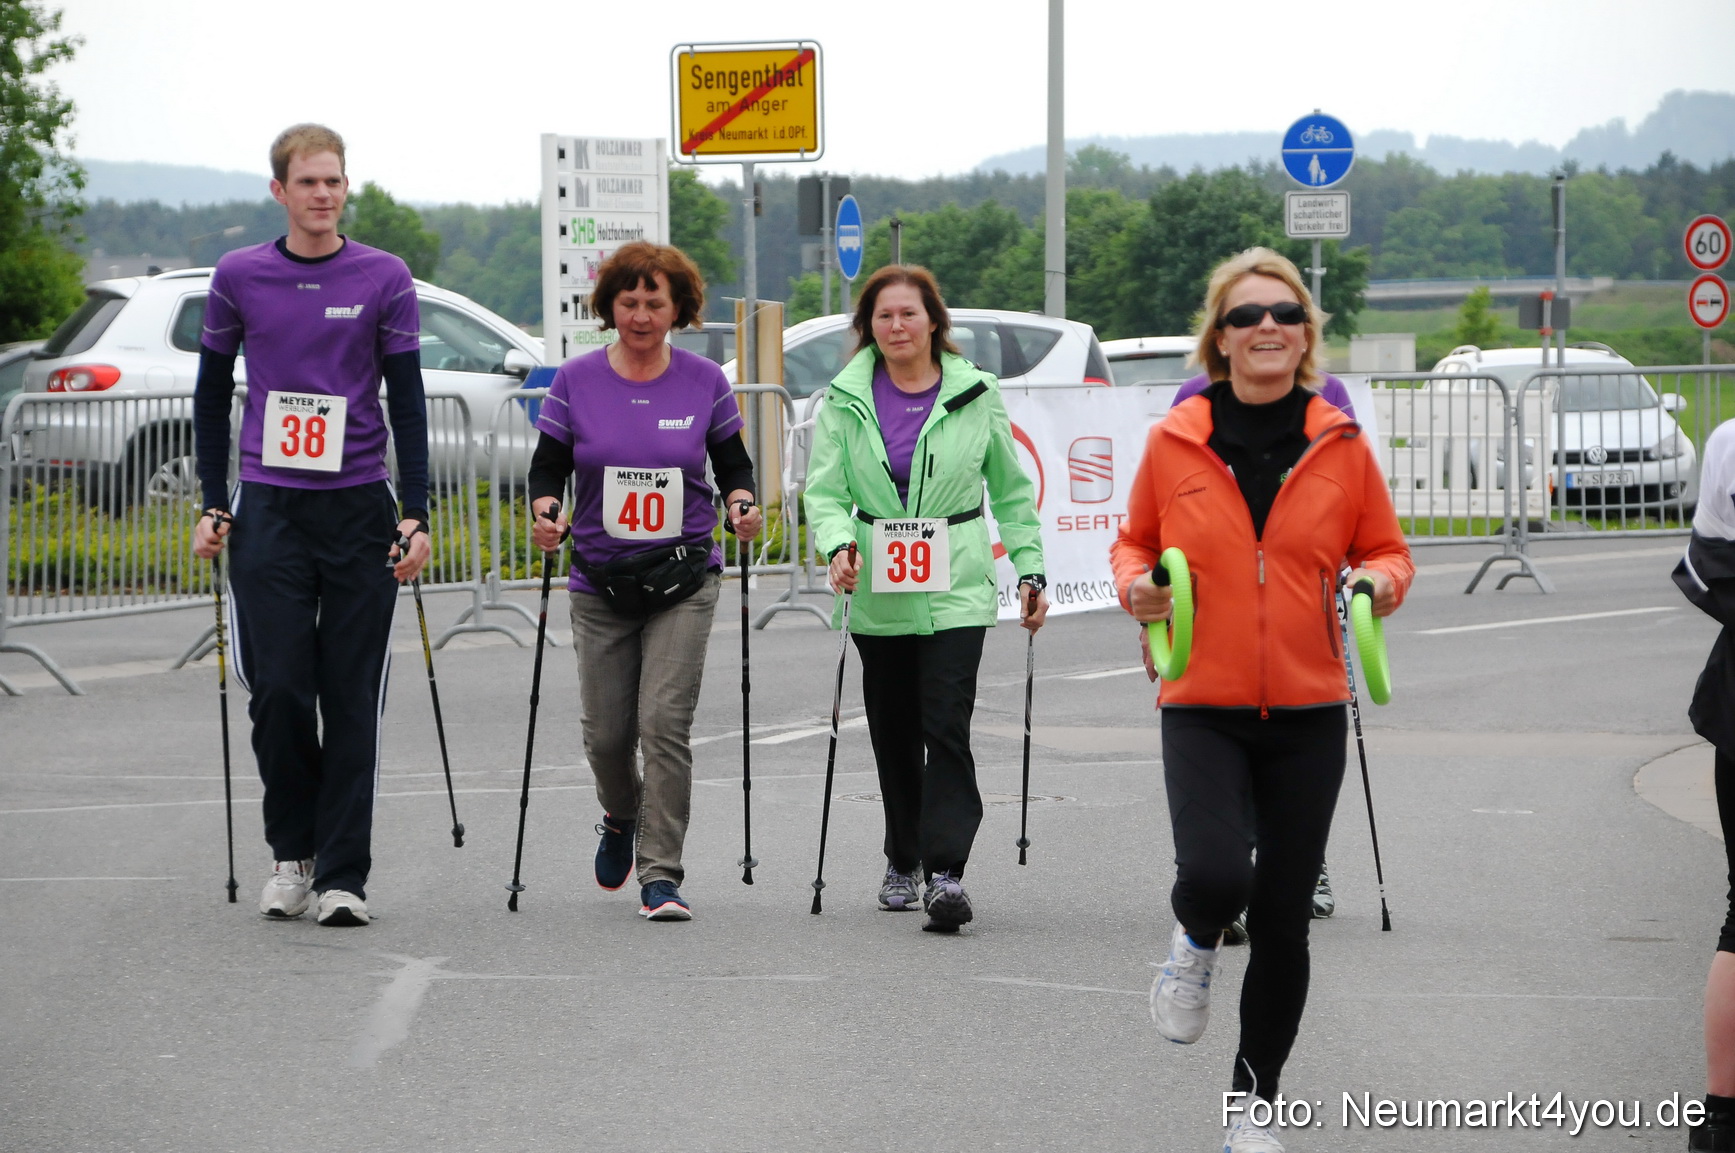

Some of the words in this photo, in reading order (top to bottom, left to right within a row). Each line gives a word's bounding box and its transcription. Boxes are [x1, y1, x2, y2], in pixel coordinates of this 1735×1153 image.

[691, 62, 804, 96] Sengenthal
[706, 100, 731, 113] am
[739, 98, 788, 116] Anger
[688, 128, 714, 141] Kreis
[719, 127, 769, 141] Neumarkt
[571, 217, 596, 244] SHB
[1695, 231, 1722, 255] 60
[278, 404, 315, 414] WERBUNG
[279, 396, 315, 407] MEYER
[280, 414, 327, 459] 38
[616, 479, 654, 488] WERBUNG
[617, 471, 653, 481] MEYER
[618, 492, 665, 532] 40
[884, 522, 919, 532] MEYER
[1057, 514, 1127, 532] SEAT
[883, 530, 920, 539] WERBUNG
[887, 540, 931, 584] 39
